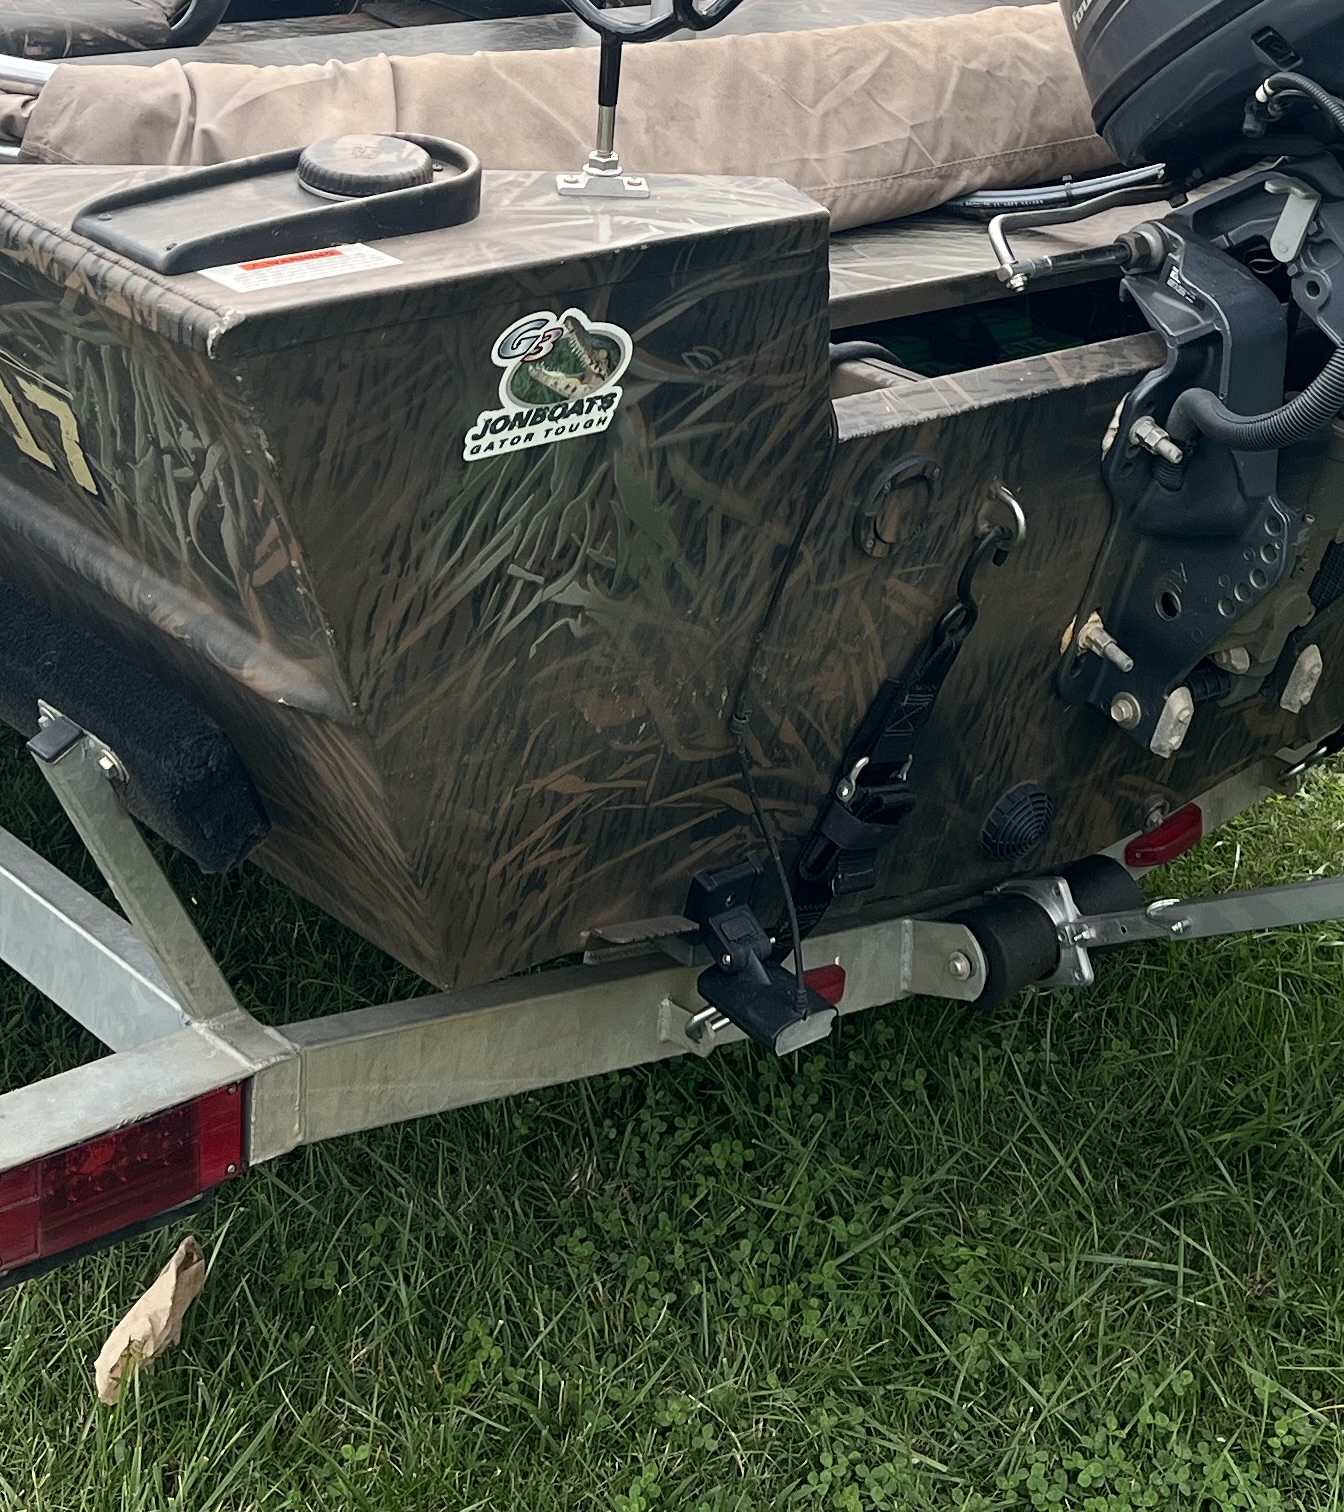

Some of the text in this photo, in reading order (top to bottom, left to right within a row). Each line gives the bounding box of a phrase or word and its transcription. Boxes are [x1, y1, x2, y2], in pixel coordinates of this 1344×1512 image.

[498, 319, 564, 363] G3
[470, 416, 608, 456] GATOR TOUGH
[471, 393, 618, 441] JONBOATS
